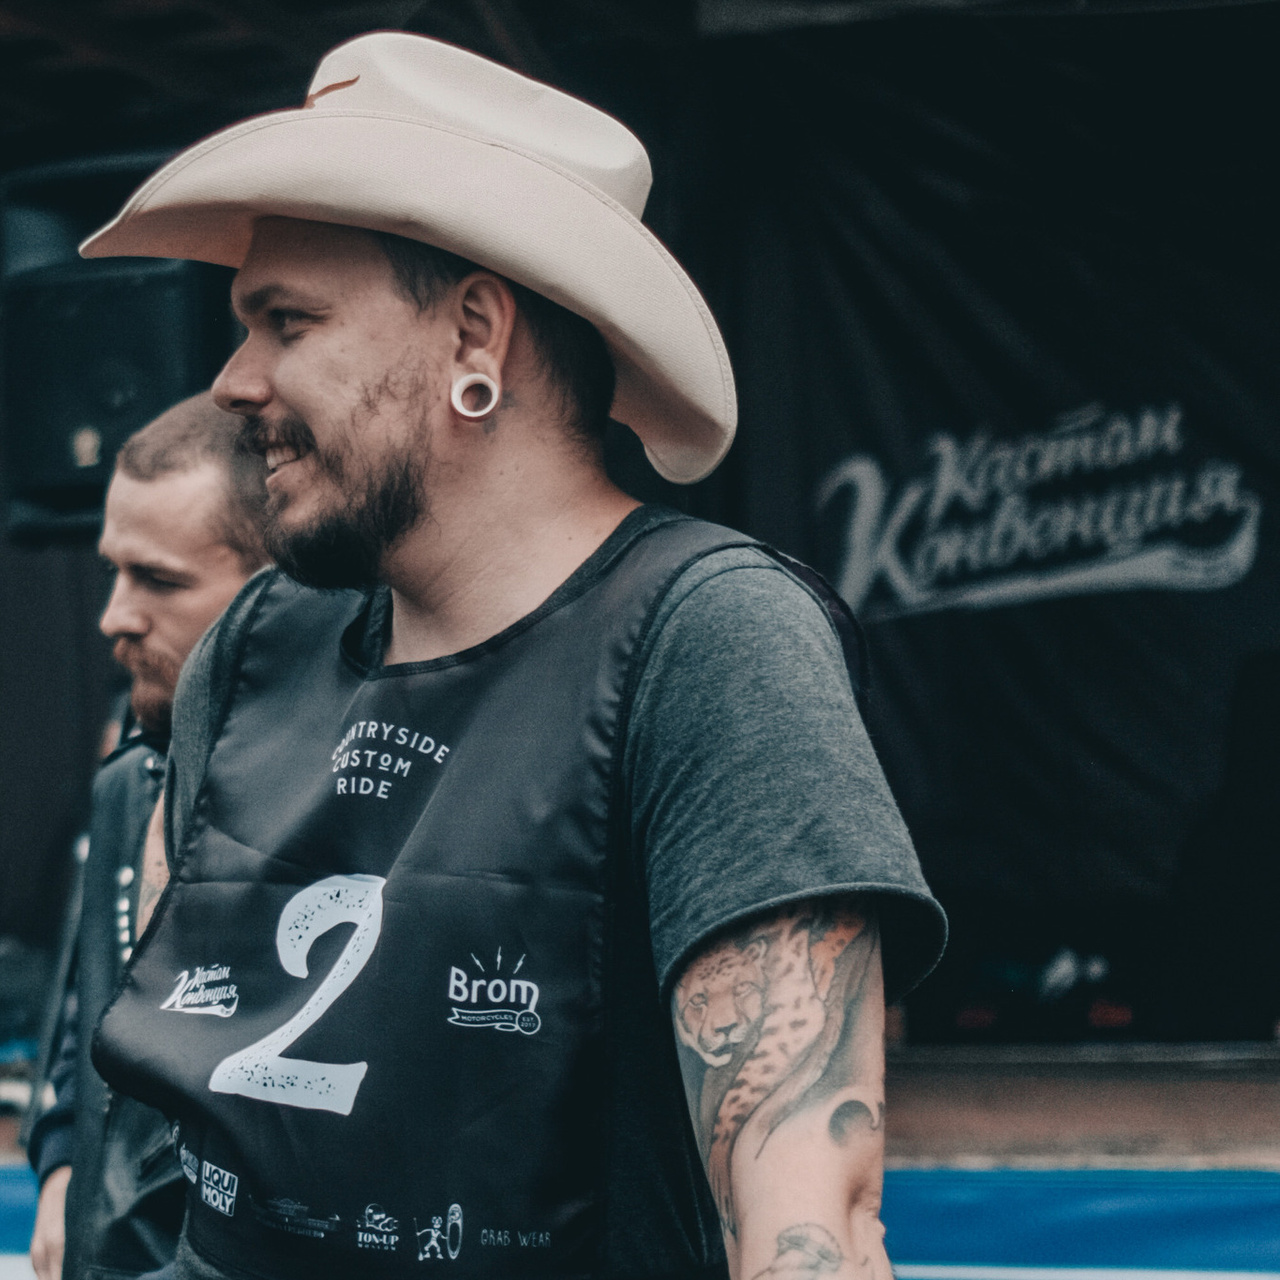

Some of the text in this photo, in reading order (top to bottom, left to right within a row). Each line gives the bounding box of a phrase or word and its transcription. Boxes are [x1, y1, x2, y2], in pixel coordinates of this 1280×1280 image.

[331, 721, 450, 764] COUNTRYSIDE
[332, 749, 412, 778] CUSTOM
[336, 776, 393, 800] RIDE
[208, 873, 387, 1116] 2
[448, 965, 540, 1011] Brom
[461, 1014, 514, 1022] MOTORCYCLES
[204, 1162, 237, 1195] LIQUI
[202, 1182, 234, 1214] MOLY
[357, 1231, 400, 1245] TON-UP
